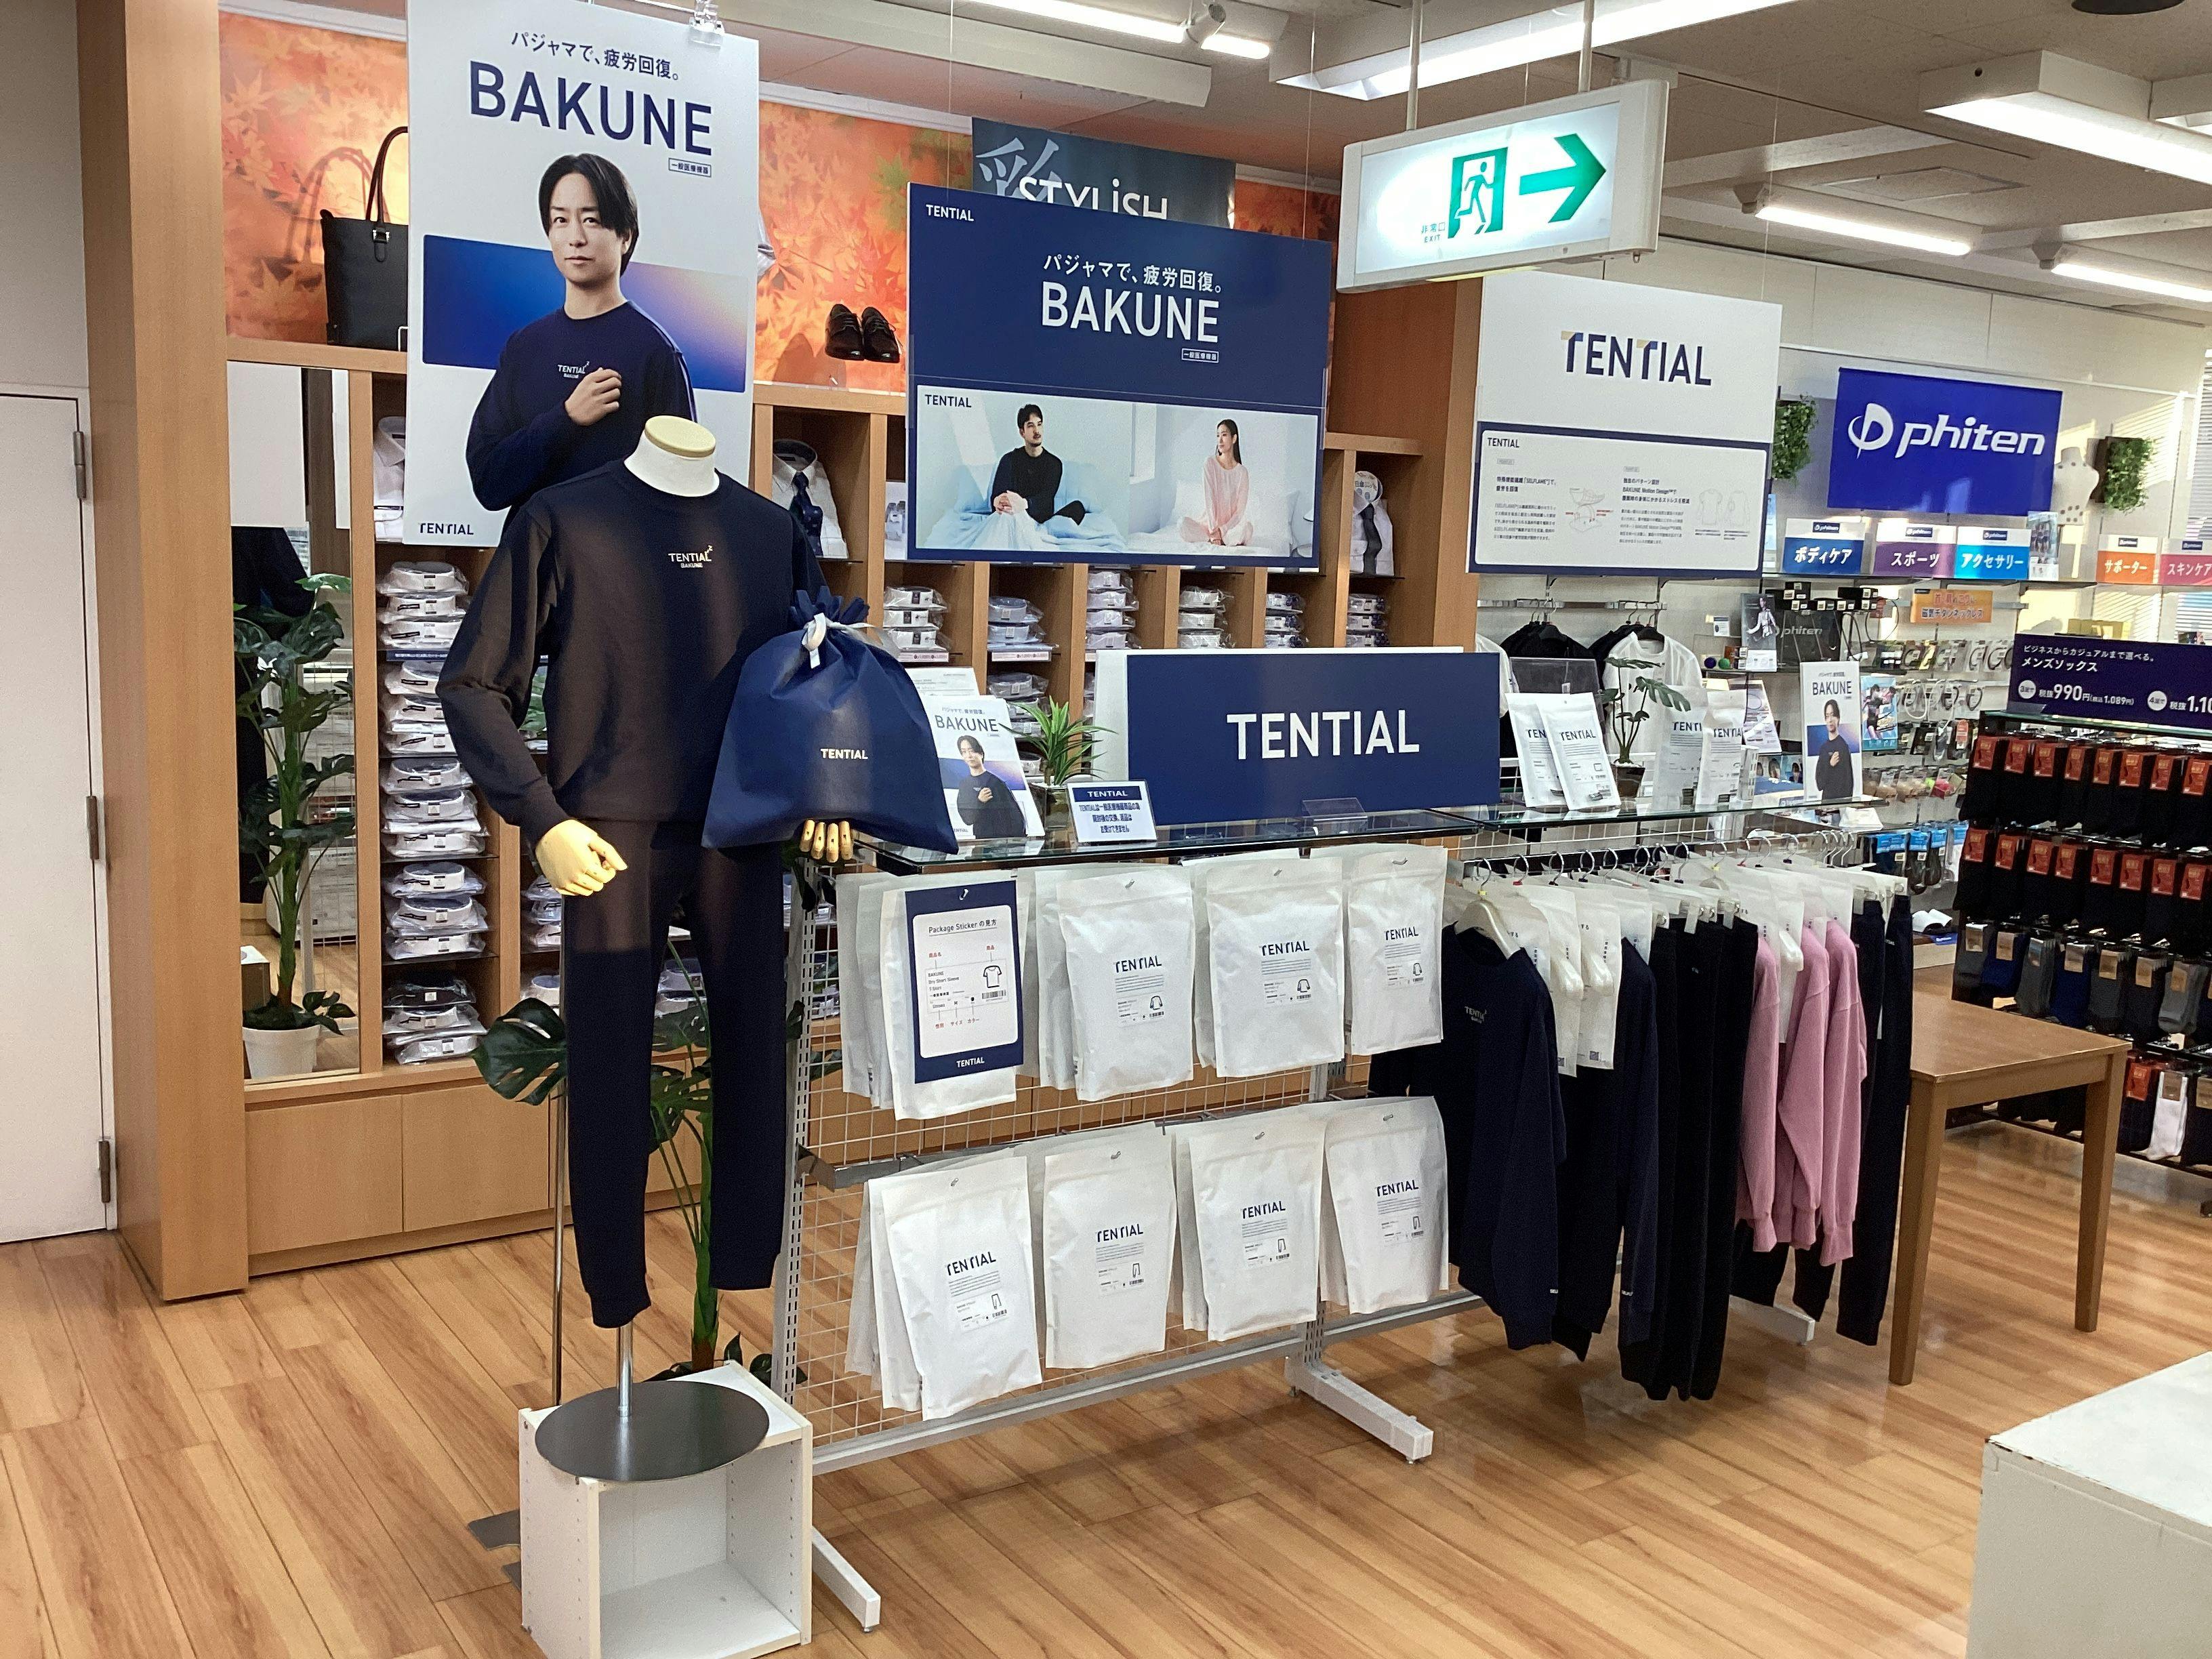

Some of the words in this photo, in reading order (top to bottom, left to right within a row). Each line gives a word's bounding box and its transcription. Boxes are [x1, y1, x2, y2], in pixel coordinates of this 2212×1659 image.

[512, 32, 678, 81] パジャマで、疲労回復。
[470, 60, 712, 156] BAKUNE
[926, 205, 974, 222] TENTIAL
[1421, 222, 1446, 234] 非常口
[1425, 234, 1441, 243] EXIT
[1043, 253, 1222, 293] パジャマで、疲労回復。
[1041, 281, 1219, 343] BAKUNE
[1561, 330, 1711, 386] TENTIAL
[557, 364, 586, 374] TENTIAL
[924, 394, 972, 408] TENTIAL
[1487, 437, 1520, 449] TENTIAL
[1895, 414, 2045, 458] phiten
[419, 523, 474, 535] TENTIAL
[668, 550, 712, 562] TENTIAL
[1795, 546, 1852, 565] ボディケア
[1891, 550, 1940, 568] スポーツ
[1961, 552, 2024, 569] アクセサリー
[2104, 559, 2148, 575] サポーター
[2167, 562, 2212, 576] スキンケア
[1781, 626, 1823, 638] phiten
[2023, 644, 2154, 662] ビジネスからカジュアルまで選べる。
[2021, 657, 2098, 672] メンズソックス
[1812, 681, 1852, 696] BAKUNE
[935, 715, 999, 732] BAKUNE
[1673, 721, 1702, 732] TENTI
[1226, 710, 1420, 760] TENTIAL
[1560, 729, 1597, 741] TENTIAL
[820, 748, 868, 760] TENTIAL
[928, 925, 954, 934] Package
[956, 922, 978, 930] Sticker
[979, 919, 997, 927] の見方
[1385, 926, 1419, 941] TENTIAL
[1259, 940, 1310, 956] TENTIAL
[1114, 955, 1162, 973] TENTIAL
[956, 1057, 985, 1068] TENTIAL
[1376, 1179, 1419, 1197] TENTIAL
[1242, 1200, 1286, 1219] TENTIAL
[1096, 1223, 1144, 1242] TENTIAL
[945, 1252, 997, 1276] TENTIAL
